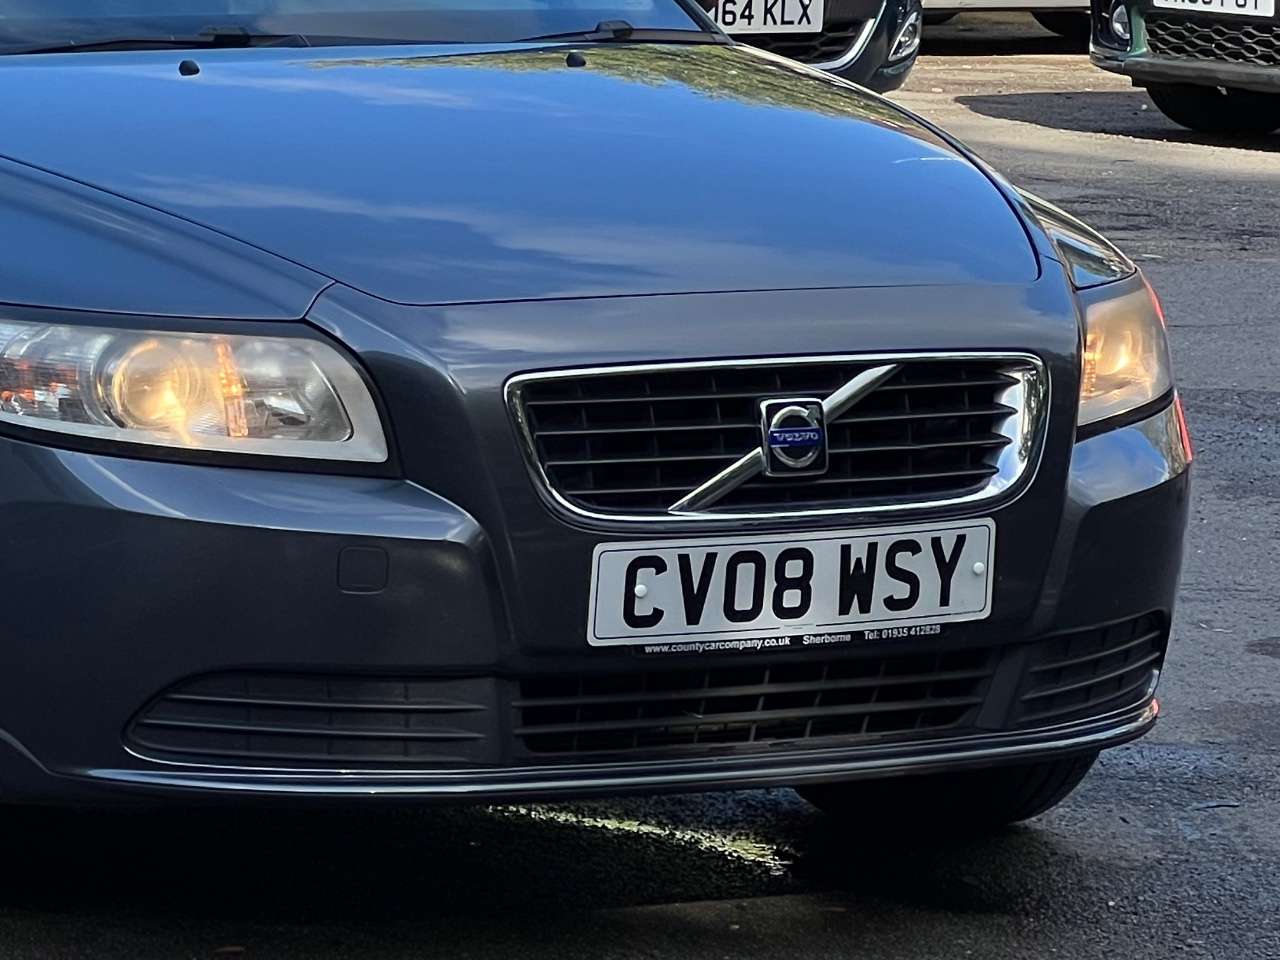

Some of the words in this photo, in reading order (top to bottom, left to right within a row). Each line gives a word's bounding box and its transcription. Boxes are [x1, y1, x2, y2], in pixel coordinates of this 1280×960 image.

[623, 547, 814, 629] CV08
[838, 534, 967, 616] WSY
[644, 636, 791, 654] www.countycarcompany.co.uk
[803, 633, 852, 645] Sherborne
[864, 630, 881, 641] Tel:
[882, 627, 908, 640] 01935
